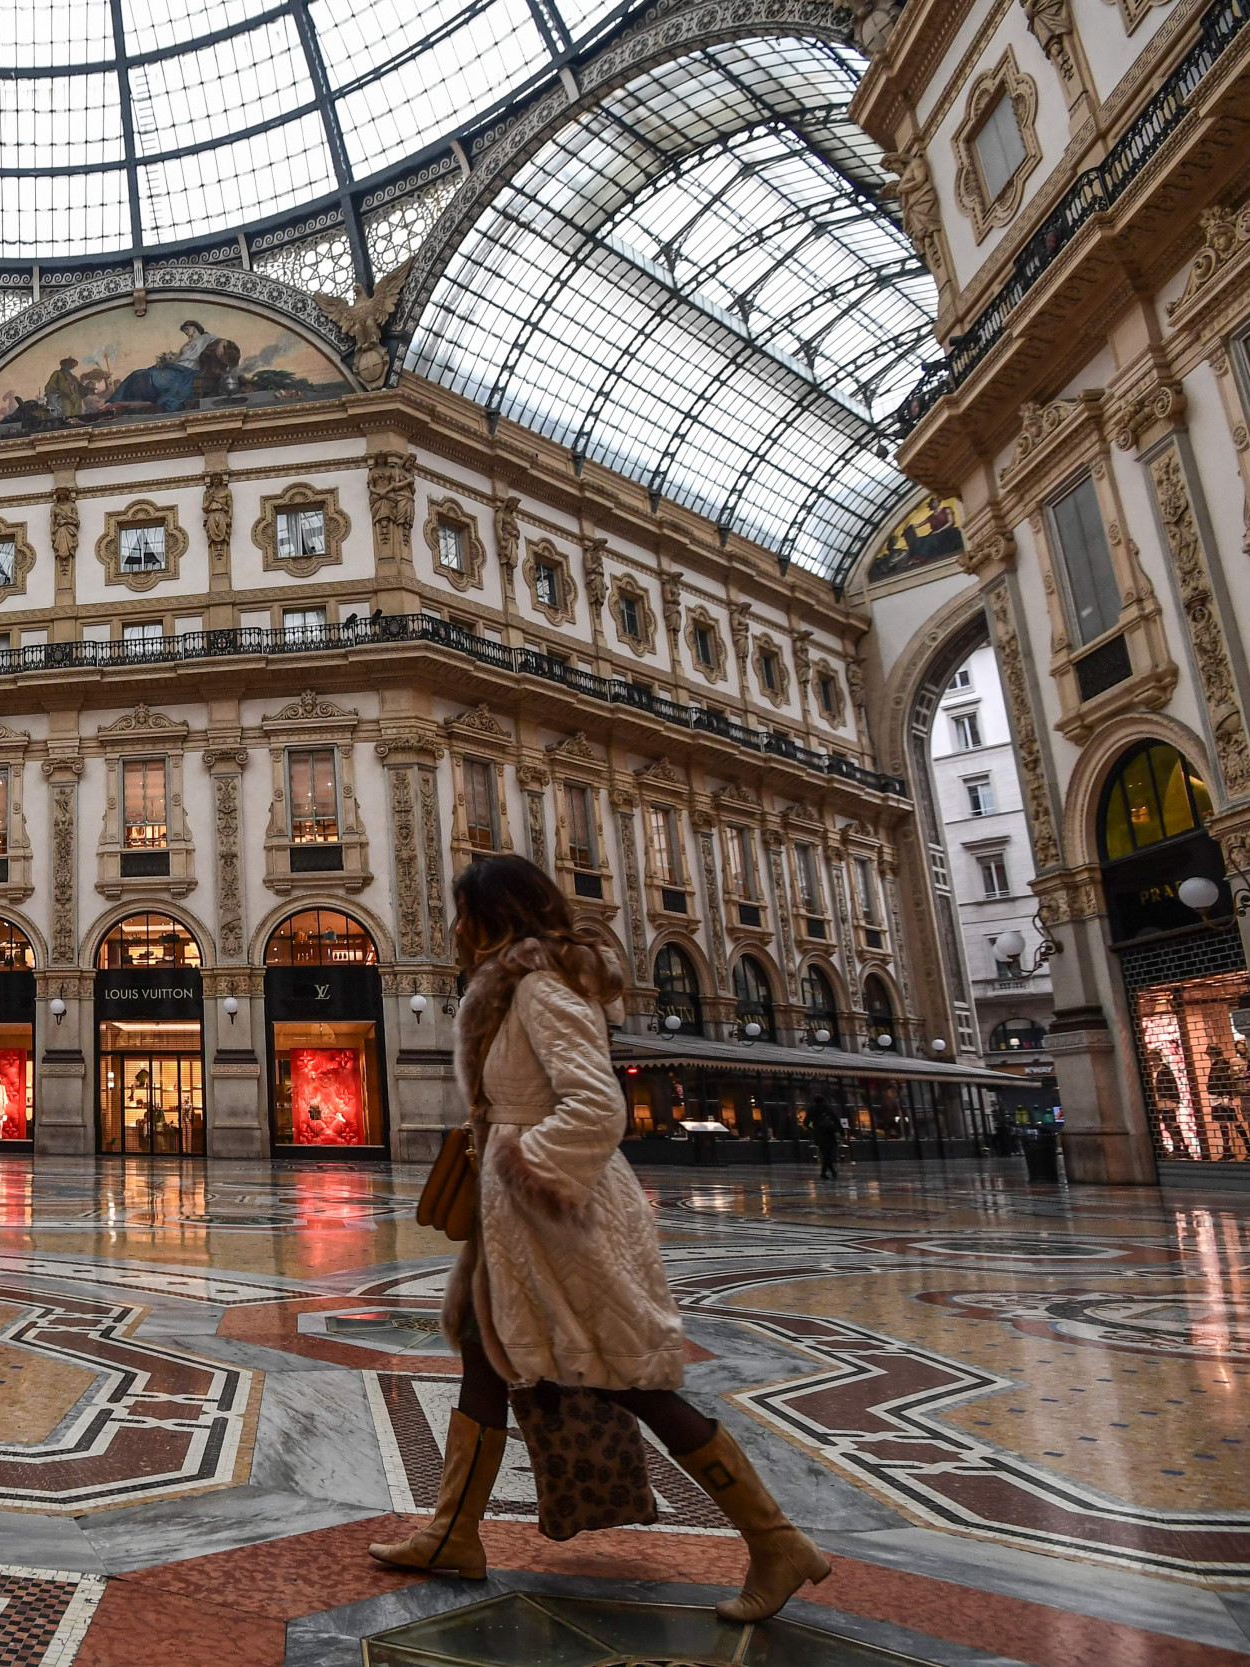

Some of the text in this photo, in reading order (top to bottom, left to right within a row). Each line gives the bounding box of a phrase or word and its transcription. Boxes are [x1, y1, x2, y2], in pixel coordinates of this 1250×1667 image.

[1140, 880, 1183, 906] PRA
[105, 988, 193, 1000] LOUIS VUITTON
